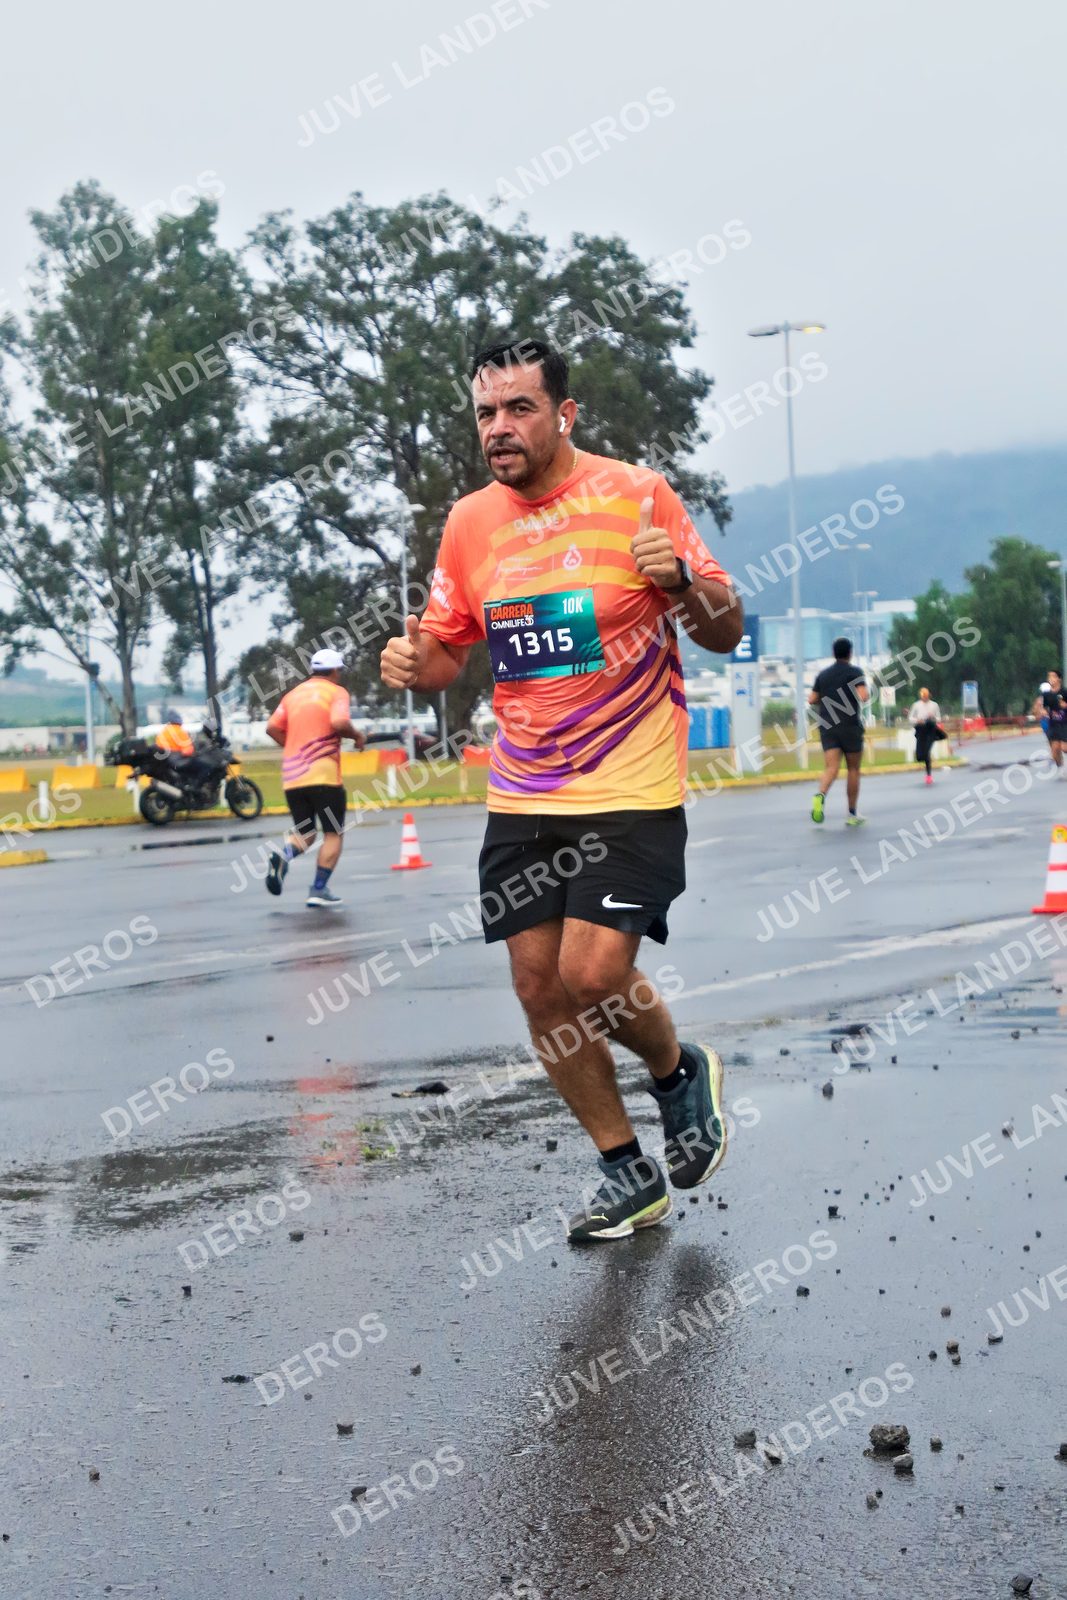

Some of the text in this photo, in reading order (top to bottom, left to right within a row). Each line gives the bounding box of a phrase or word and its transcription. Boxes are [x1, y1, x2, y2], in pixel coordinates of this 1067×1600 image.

[490, 603, 534, 621] CARRERA
[562, 596, 584, 615] 10K
[508, 627, 574, 657] 1315
